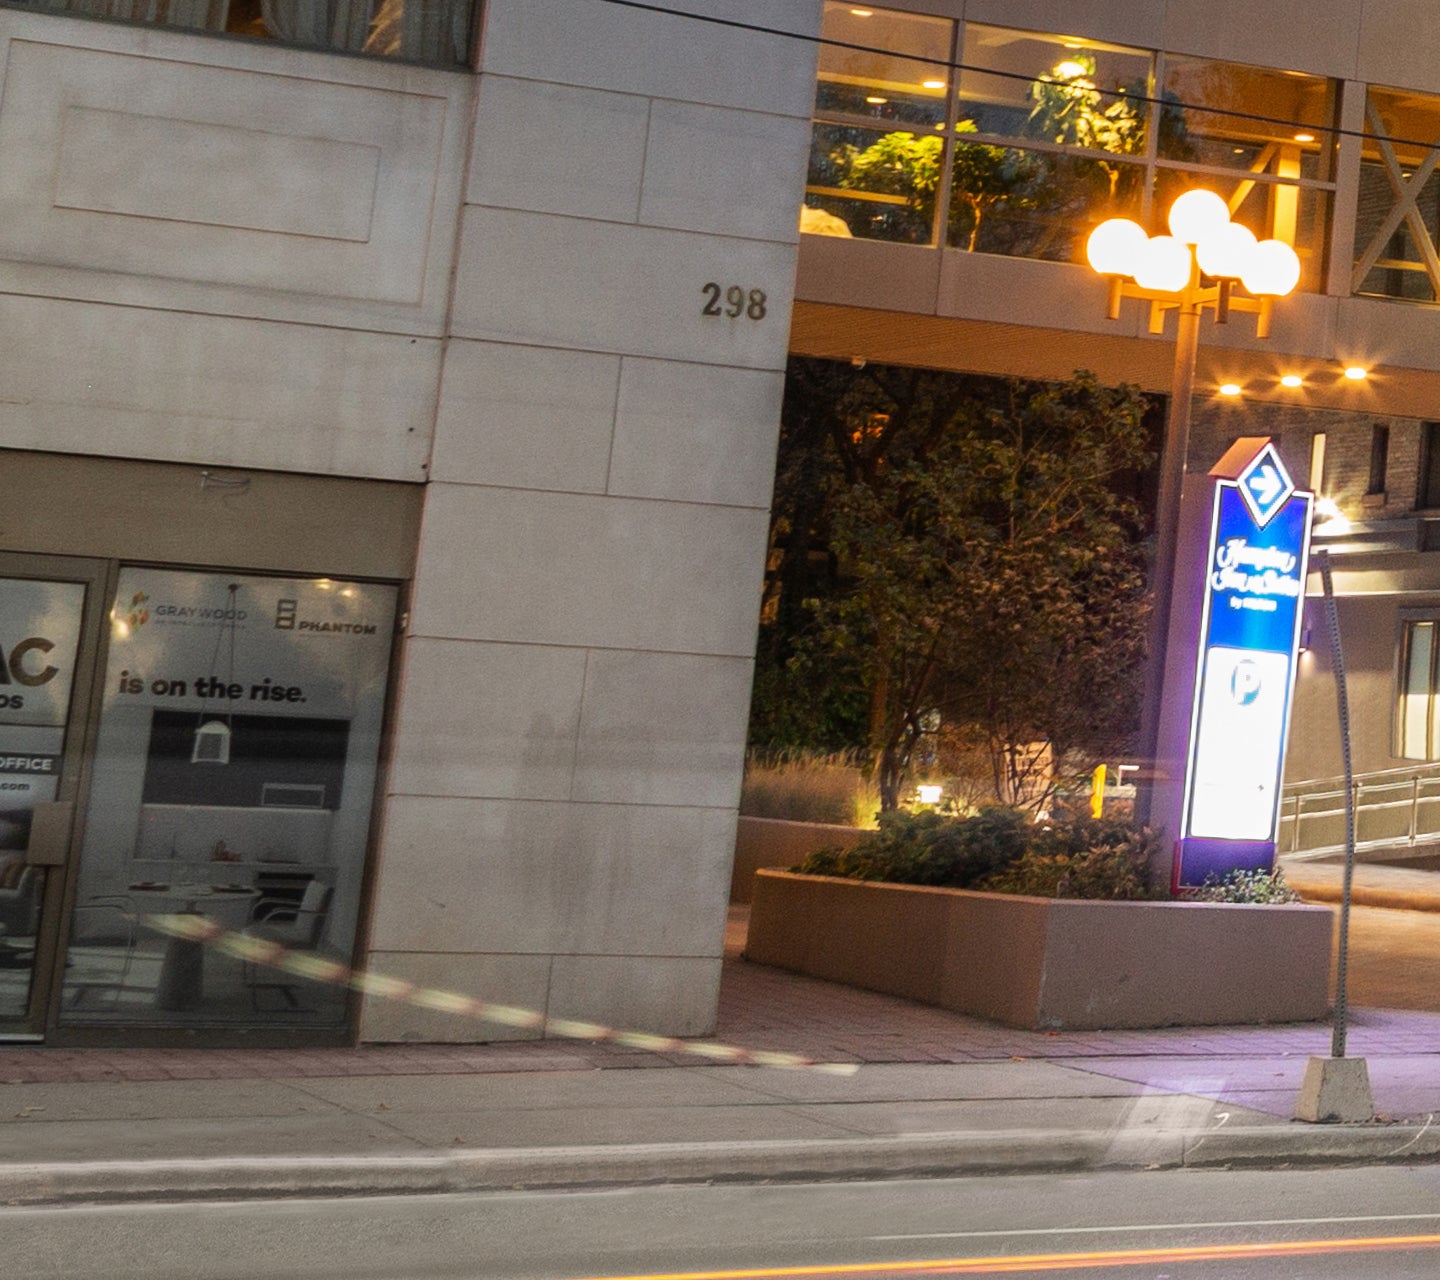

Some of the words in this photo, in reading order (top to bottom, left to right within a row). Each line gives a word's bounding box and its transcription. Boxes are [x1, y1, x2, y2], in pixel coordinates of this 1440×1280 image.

[702, 282, 768, 320] 298
[155, 605, 247, 621] GRAYWOOD
[298, 620, 377, 635] PHANTOM
[119, 670, 144, 694] is
[151, 680, 186, 697] on
[194, 676, 243, 700] the
[250, 678, 307, 703] rise.
